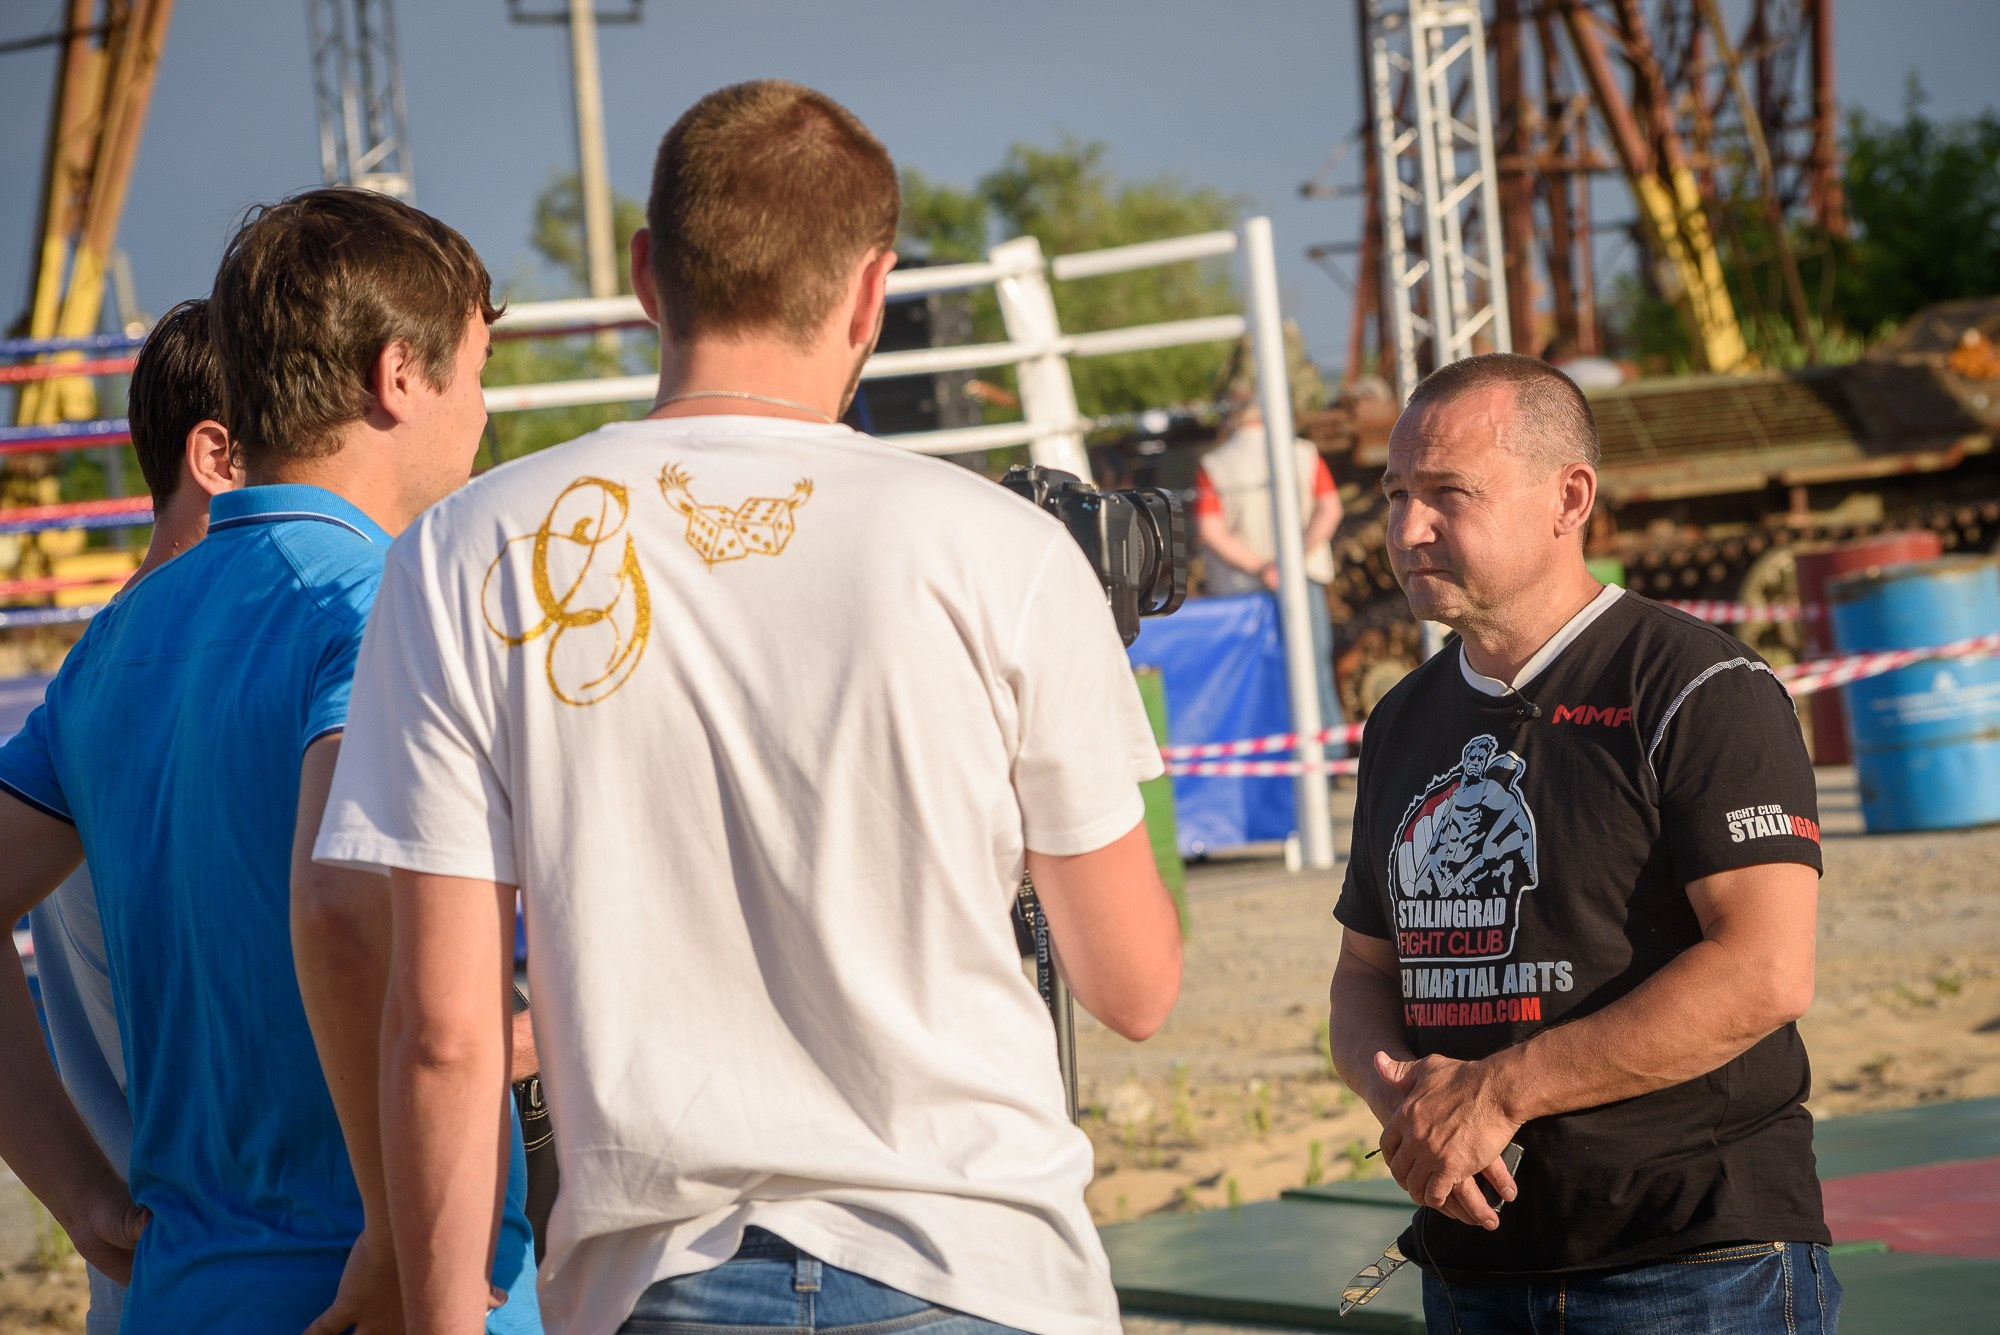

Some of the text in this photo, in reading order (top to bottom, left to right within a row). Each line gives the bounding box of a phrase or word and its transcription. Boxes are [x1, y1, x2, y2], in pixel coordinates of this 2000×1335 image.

[1726, 804, 1783, 822] FIGHT CLUB
[1728, 813, 1821, 847] STALINGRA
[1398, 897, 1507, 929] STALINGRAD
[1399, 929, 1505, 955] FIGHT CLUB
[1415, 966, 1500, 999] MARTIAL
[1502, 960, 1574, 995] ARTS
